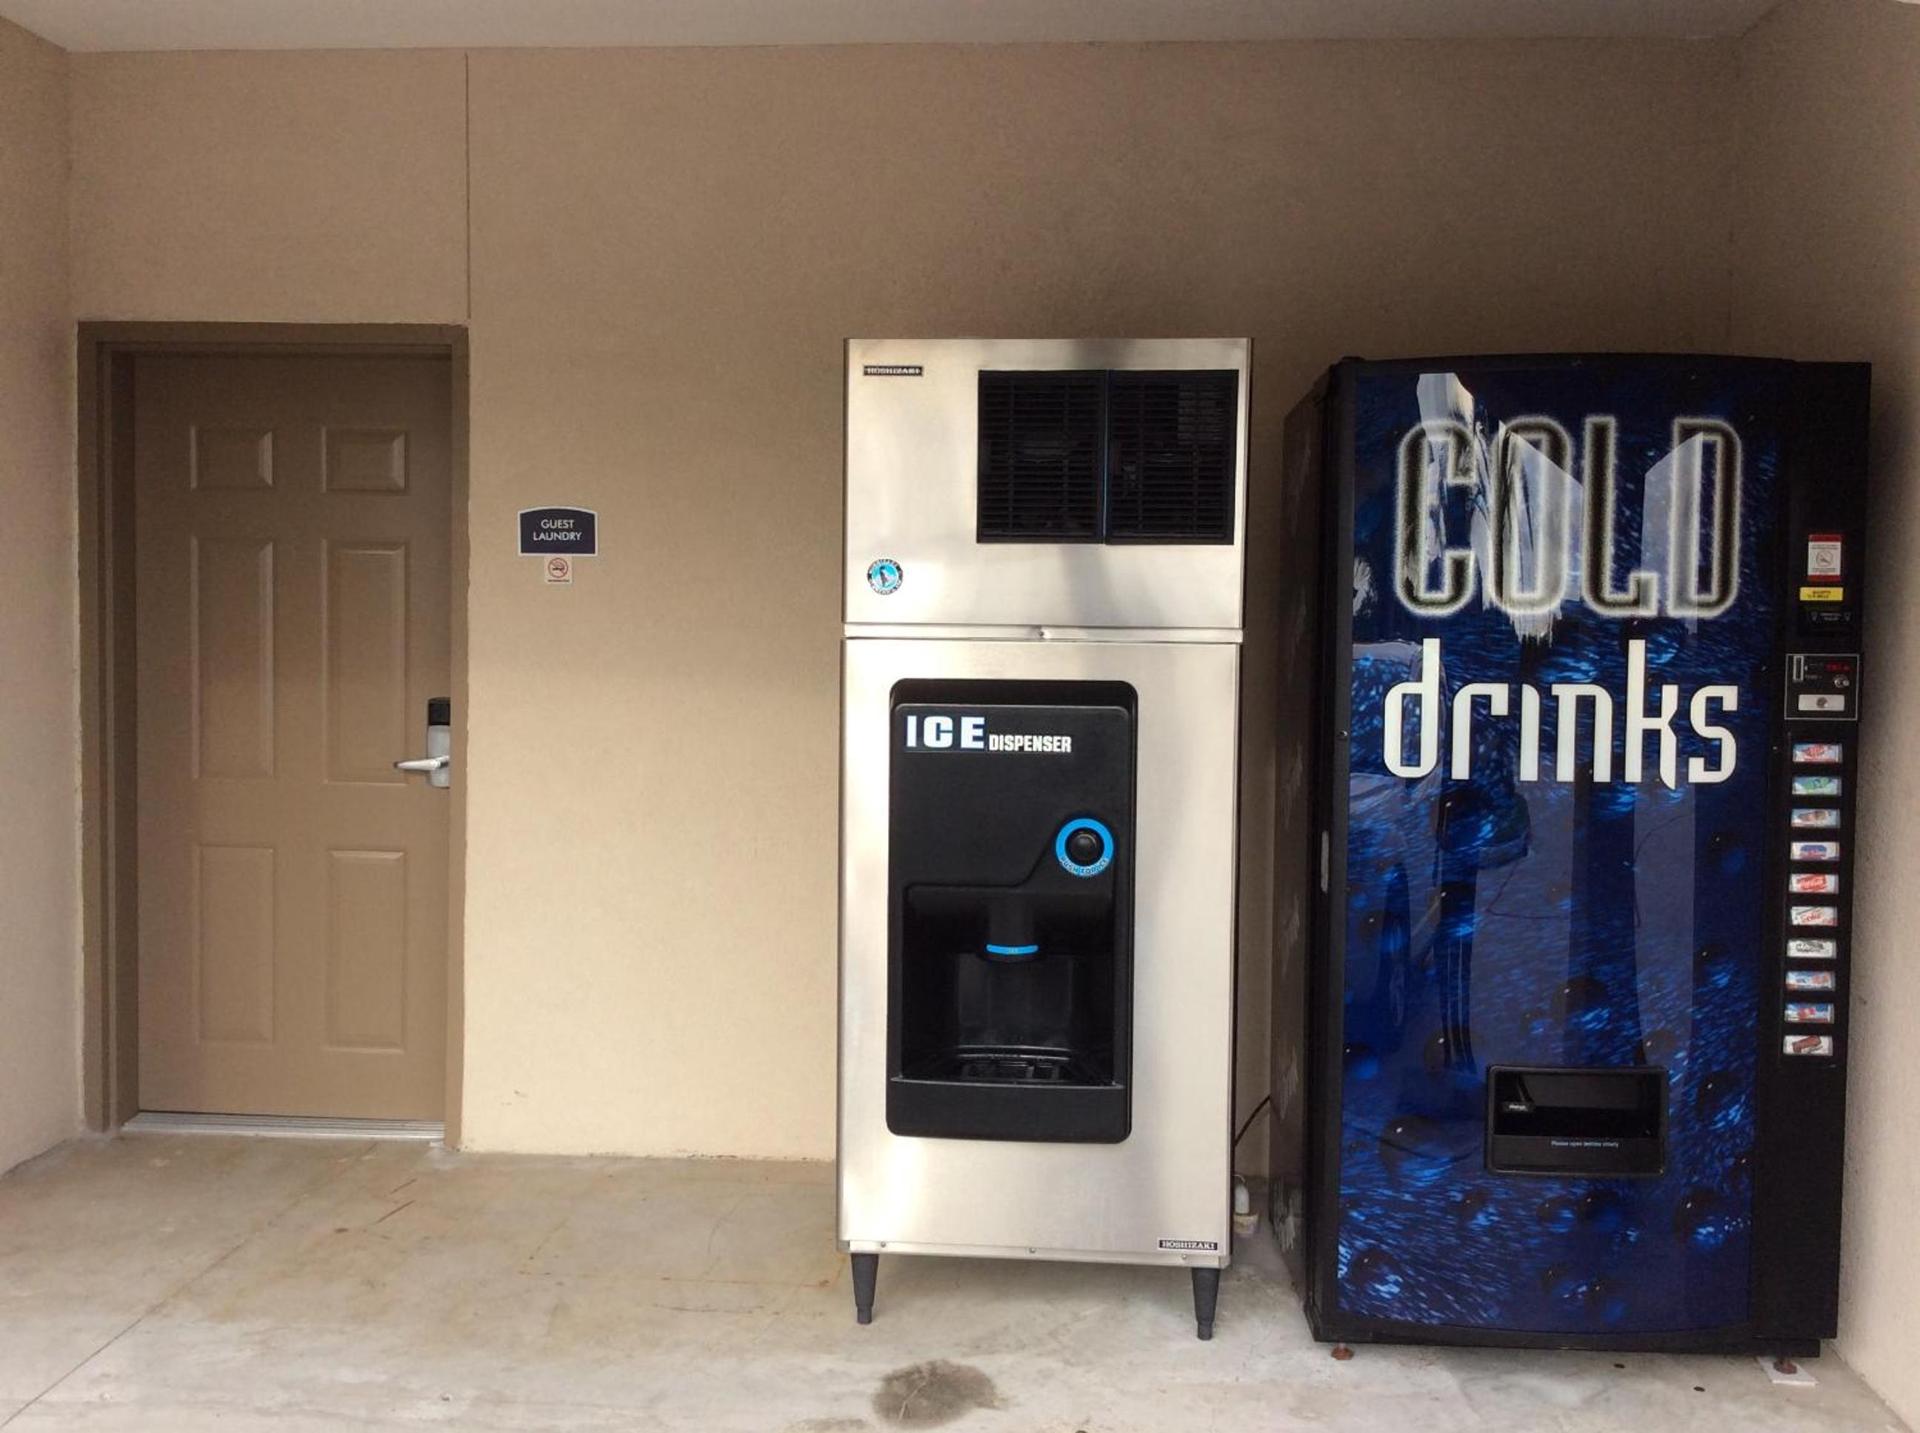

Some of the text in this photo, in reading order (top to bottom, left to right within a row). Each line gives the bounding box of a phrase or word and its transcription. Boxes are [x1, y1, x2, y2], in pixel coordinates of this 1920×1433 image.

[540, 519, 575, 529] GUEST
[1396, 414, 1743, 619] COLD
[533, 531, 582, 541] LAUNDRY
[1383, 638, 1739, 790] drinks
[906, 715, 1073, 753] ICE DISPENSER
